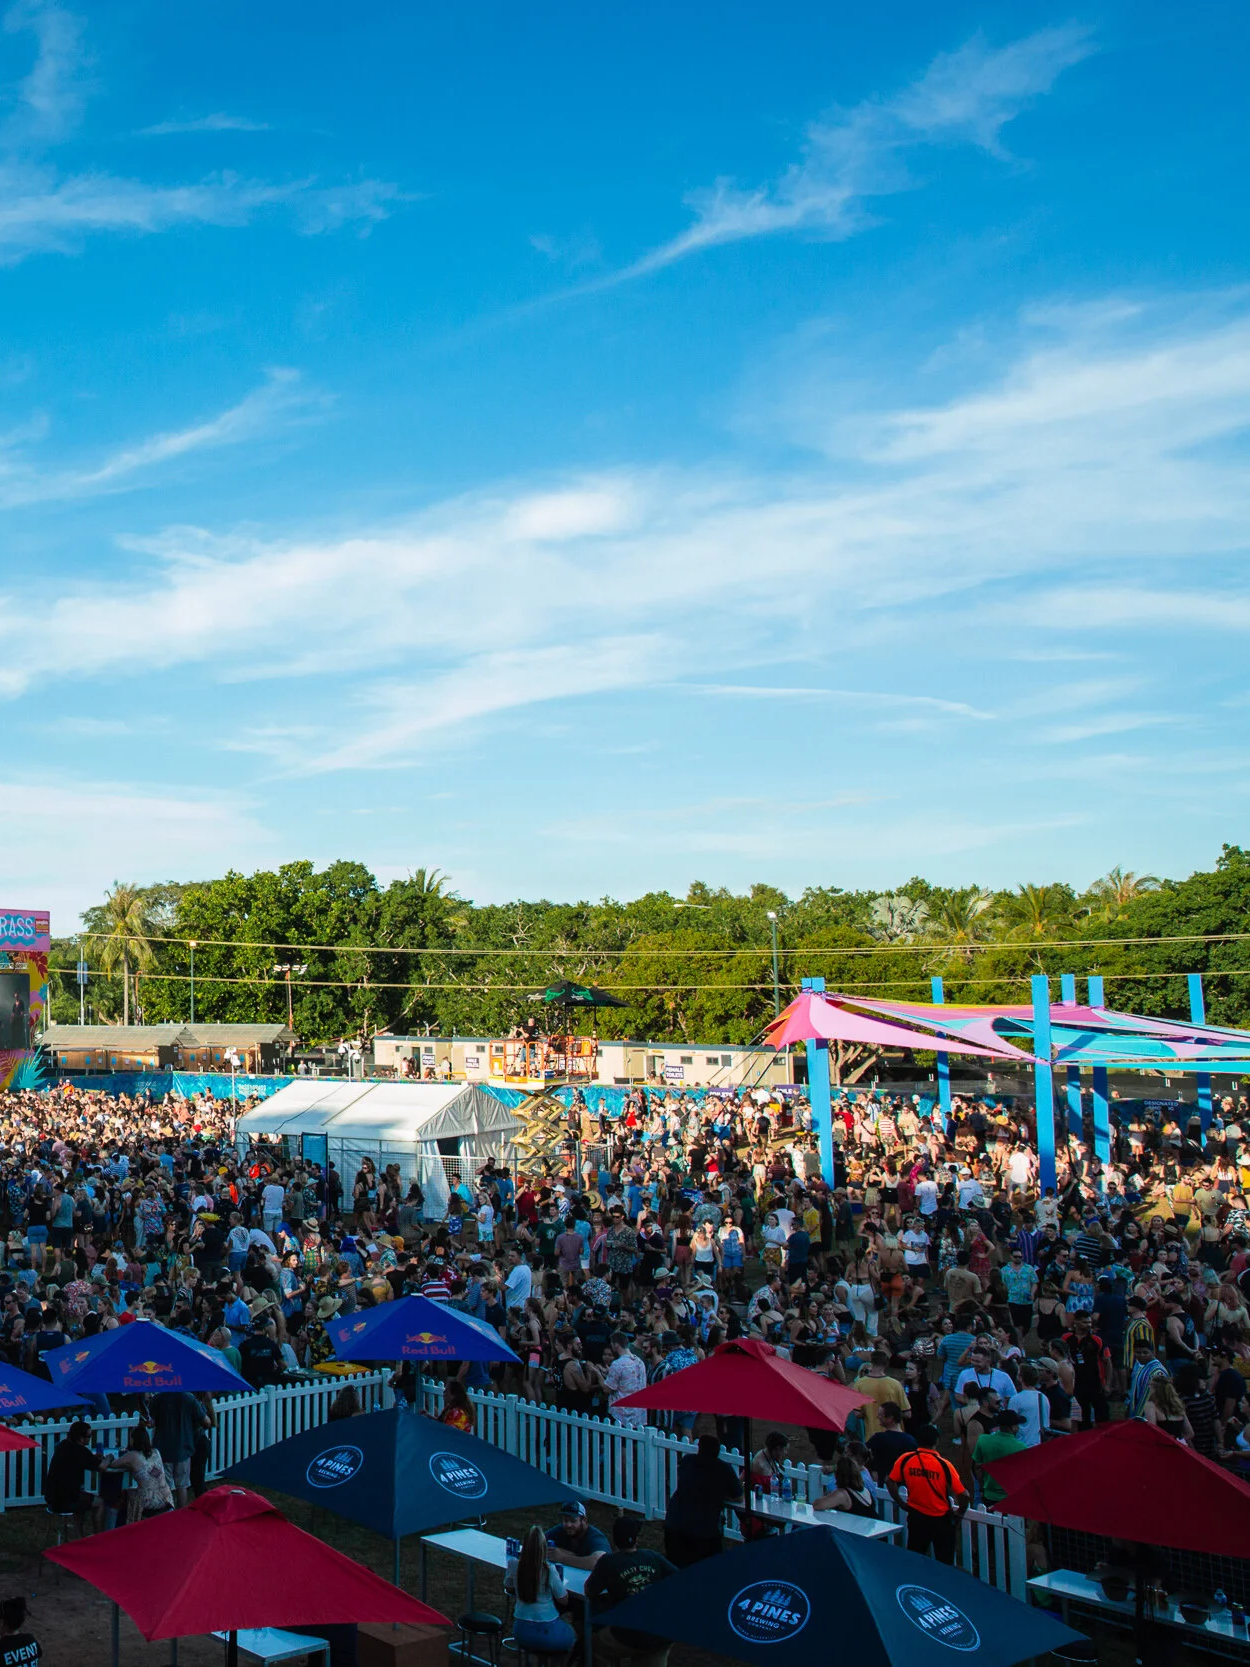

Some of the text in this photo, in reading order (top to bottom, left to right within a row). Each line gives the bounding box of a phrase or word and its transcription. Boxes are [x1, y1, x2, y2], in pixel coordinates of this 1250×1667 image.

[401, 1345, 457, 1356] Red Bull
[123, 1375, 183, 1388] Red Bull
[0, 1394, 28, 1409] Bull
[323, 1459, 354, 1475] PINES
[446, 1468, 478, 1482] PINES
[738, 1598, 802, 1625] 4 PINES
[922, 1605, 959, 1627] PINES
[746, 1614, 780, 1629] BREWING
[3, 1641, 38, 1666] EVENT
